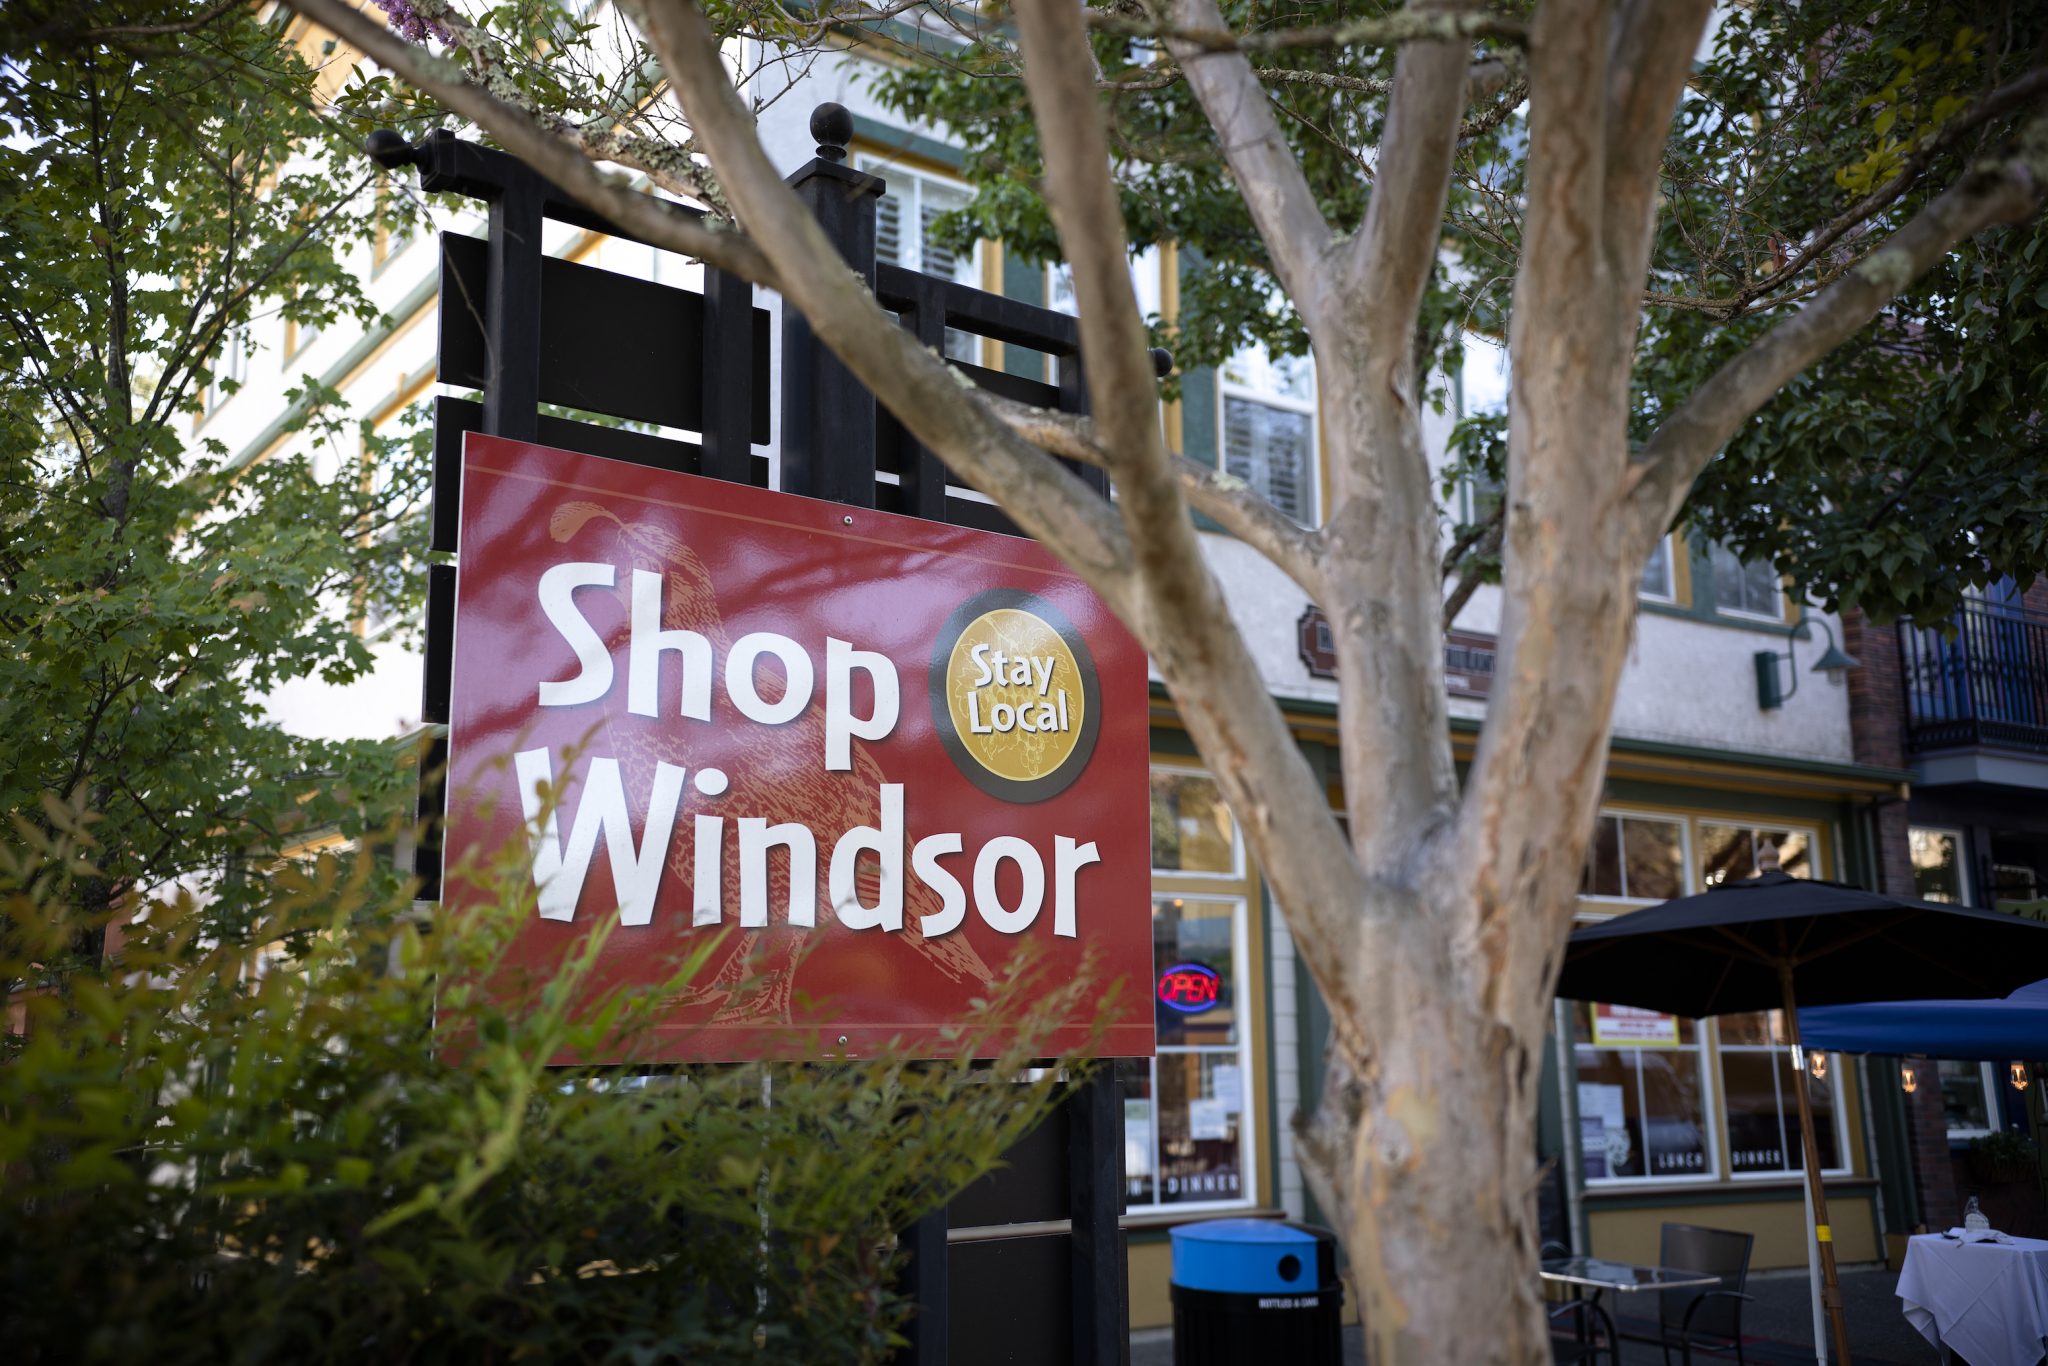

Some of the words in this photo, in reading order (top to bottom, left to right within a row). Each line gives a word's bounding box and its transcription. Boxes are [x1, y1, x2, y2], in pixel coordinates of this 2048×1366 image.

[538, 562, 900, 771] Shop
[971, 643, 1055, 695] Stay
[967, 688, 1069, 733] Local
[514, 747, 1101, 938] Windsor
[1158, 974, 1219, 1002] OPEN
[1658, 1152, 1703, 1168] LUNCH
[1732, 1150, 1780, 1166] DINNER
[1167, 1174, 1239, 1194] DINNER
